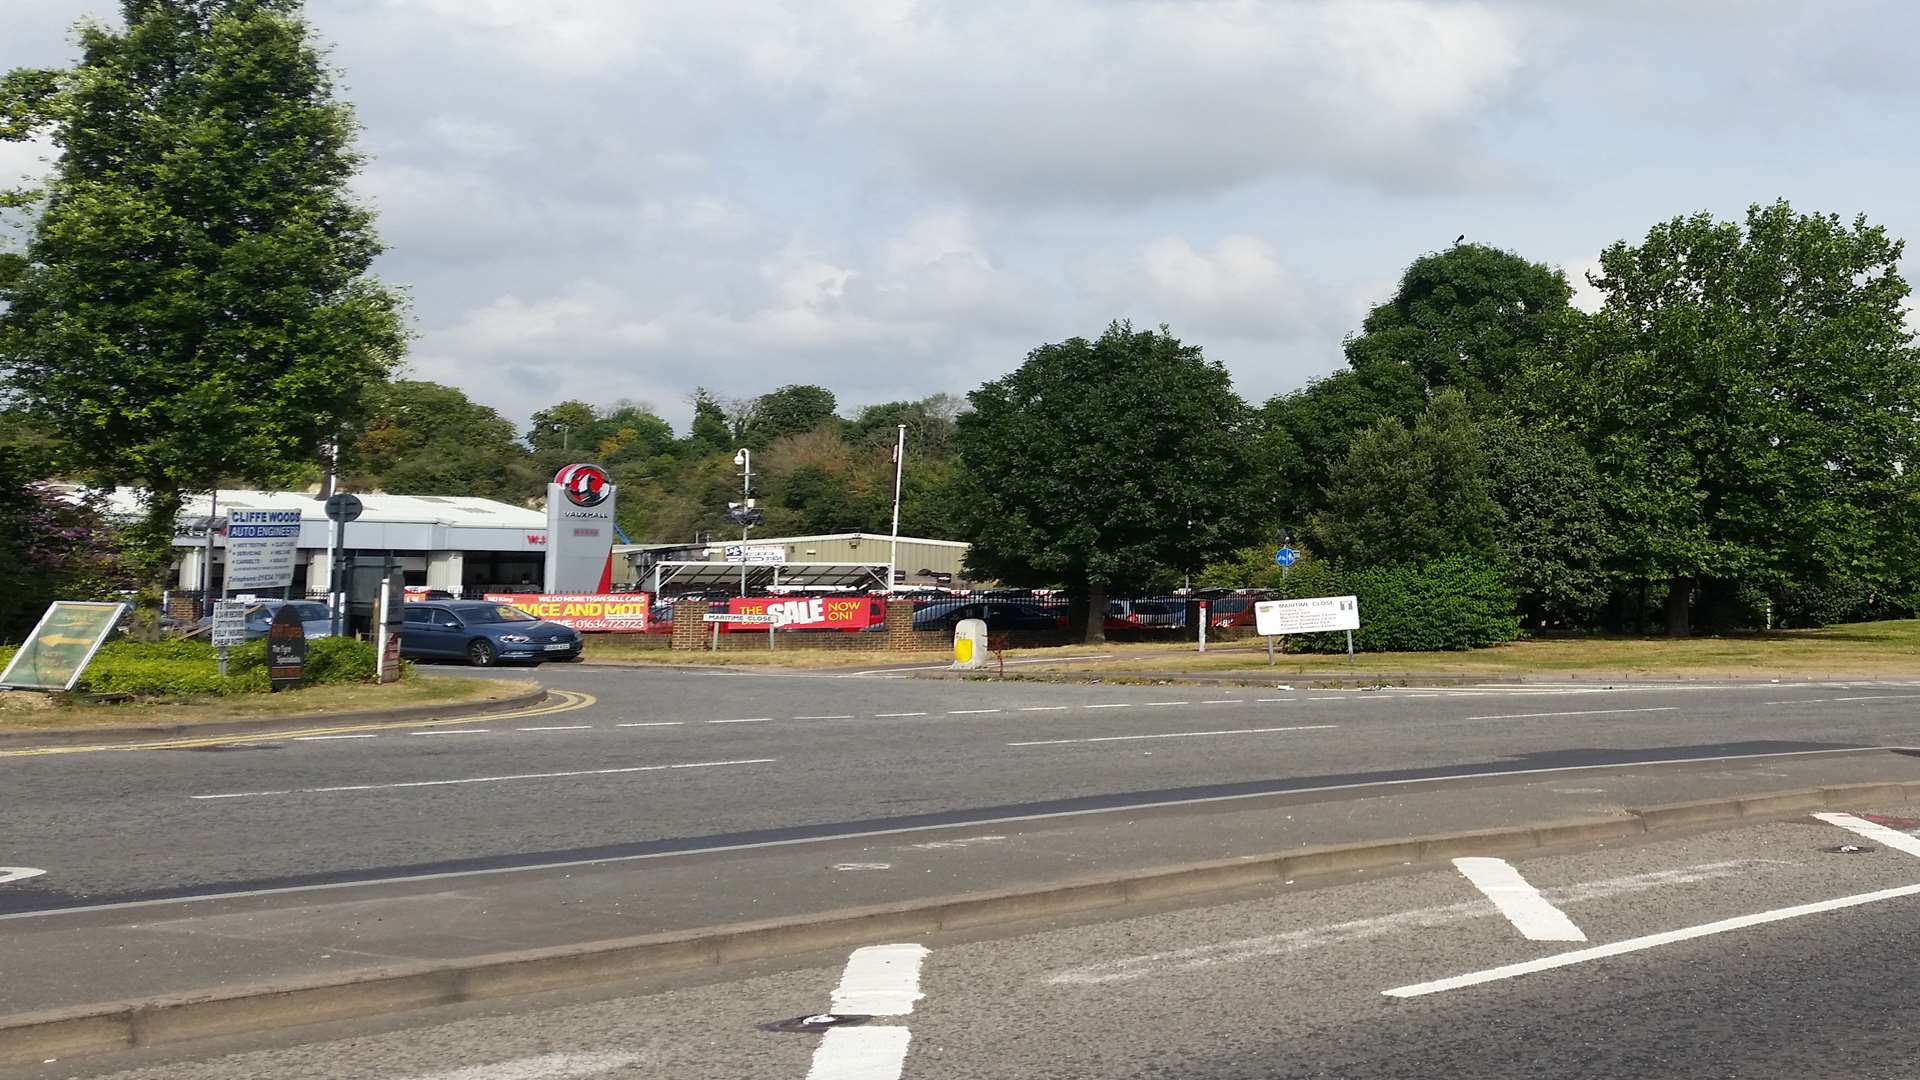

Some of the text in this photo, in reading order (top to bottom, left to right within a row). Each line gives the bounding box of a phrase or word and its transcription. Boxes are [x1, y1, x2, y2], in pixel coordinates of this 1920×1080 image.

[232, 511, 301, 522] CLIFFE WOODS
[564, 511, 609, 519] VAUXHALL
[231, 526, 300, 537] AUTO ENGINEERS
[562, 603, 602, 617] AND
[604, 602, 645, 616] MOT
[740, 606, 763, 615] THE
[828, 601, 861, 612] NOW
[767, 599, 825, 628] SALE
[828, 611, 853, 621] ON!
[575, 619, 605, 628] 01634
[607, 619, 645, 628] 723723
